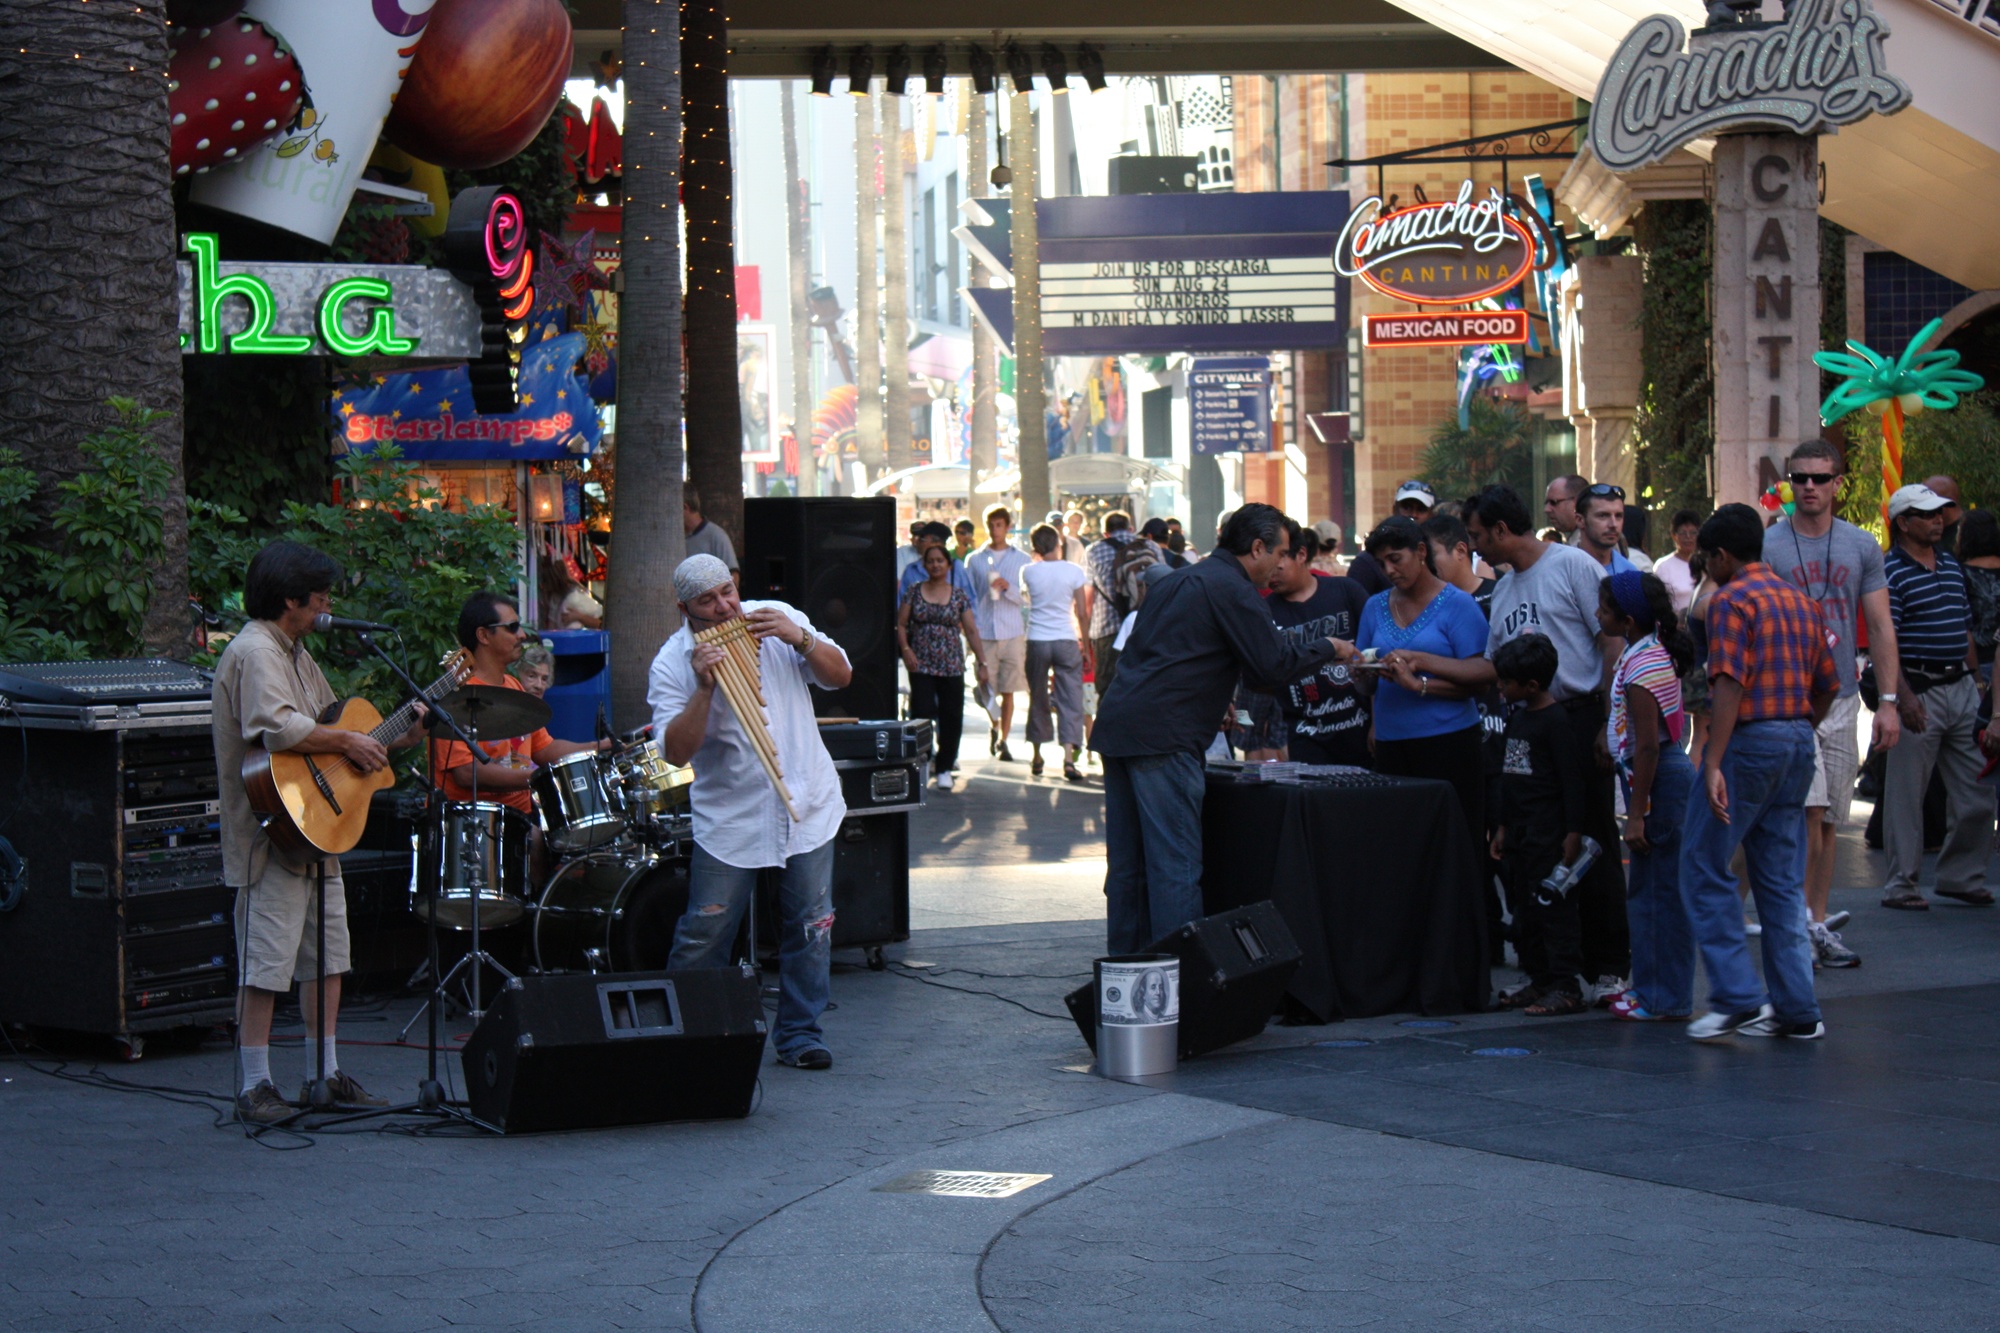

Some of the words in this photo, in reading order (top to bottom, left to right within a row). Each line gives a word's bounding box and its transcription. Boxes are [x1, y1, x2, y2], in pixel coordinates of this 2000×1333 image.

[1592, 0, 1903, 166] Camacho's
[242, 150, 351, 207] tural
[1093, 262, 1126, 277] JOIN
[1133, 260, 1152, 276] US
[1158, 260, 1185, 276] FOR
[1194, 259, 1271, 275] DESCARGA
[1379, 264, 1511, 284] CANTINA
[180, 231, 421, 357] ha
[1133, 278, 1161, 293] SUN
[1173, 277, 1204, 292] AUG
[1212, 276, 1229, 291] 24
[1134, 293, 1230, 309] CURANDEROS
[1073, 312, 1085, 327] M
[1092, 311, 1152, 326] DANIELA
[1160, 310, 1168, 325] Y
[1175, 310, 1230, 325] SONIDO
[1240, 308, 1295, 323] LASSER
[1375, 320, 1459, 338] MEXICAN
[1463, 318, 1516, 335] FOOD
[1750, 153, 1793, 526] CANTIN
[1194, 372, 1263, 384] CITYWALK
[1204, 401, 1228, 409] Parking
[346, 413, 558, 447] Starlamps
[1205, 433, 1229, 441] Parking
[1791, 561, 1850, 588] OHIO
[1503, 602, 1541, 636] USA
